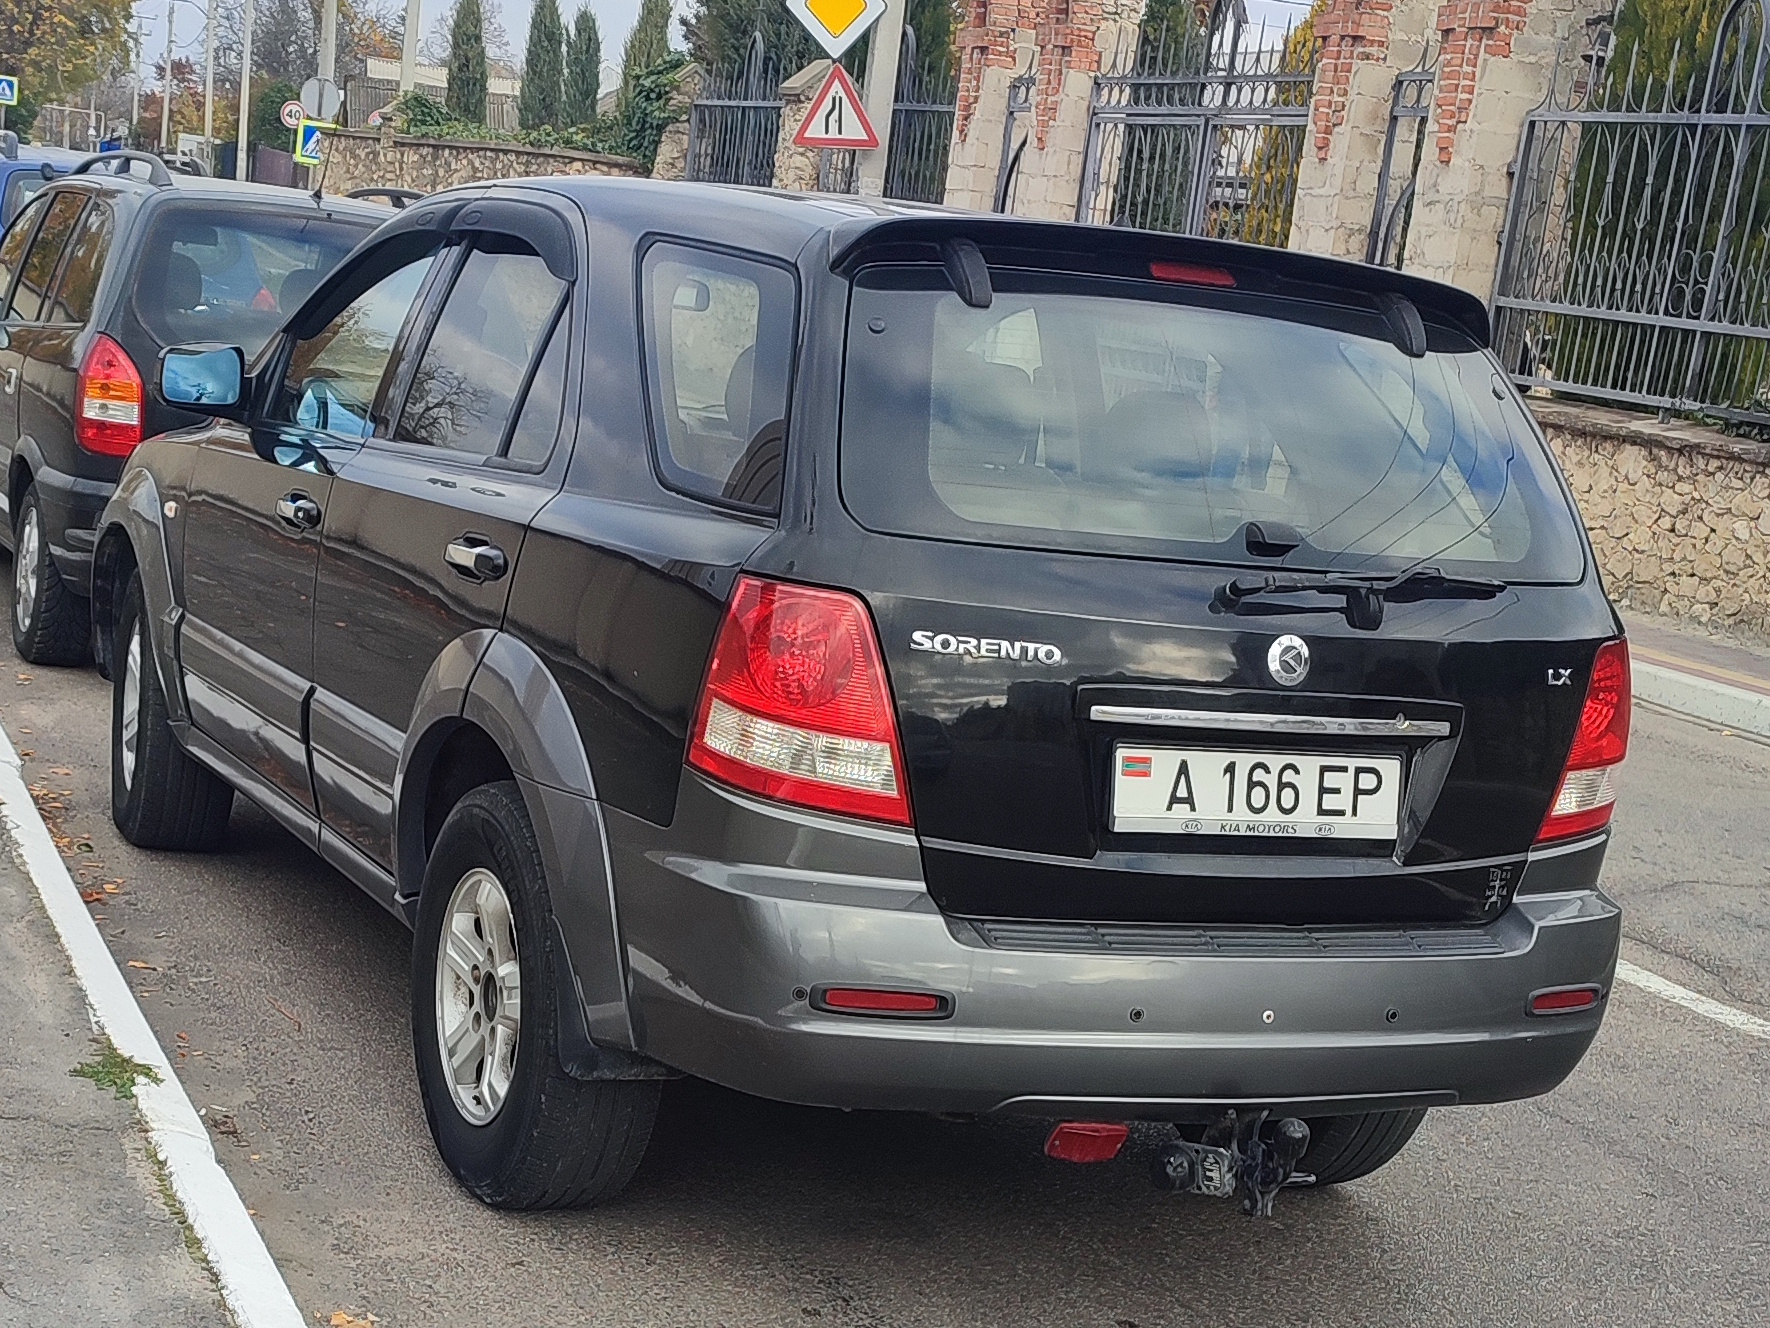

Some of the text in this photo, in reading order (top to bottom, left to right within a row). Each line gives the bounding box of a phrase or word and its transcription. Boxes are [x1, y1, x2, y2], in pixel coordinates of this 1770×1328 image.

[286, 109, 301, 120] 40
[909, 630, 1062, 665] SORENTO
[1547, 668, 1573, 686] LX
[1165, 758, 1383, 818] A 166 EP
[1183, 822, 1201, 832] KIA
[1219, 822, 1298, 834] KIA MOTORS
[1316, 825, 1333, 835] KIA
